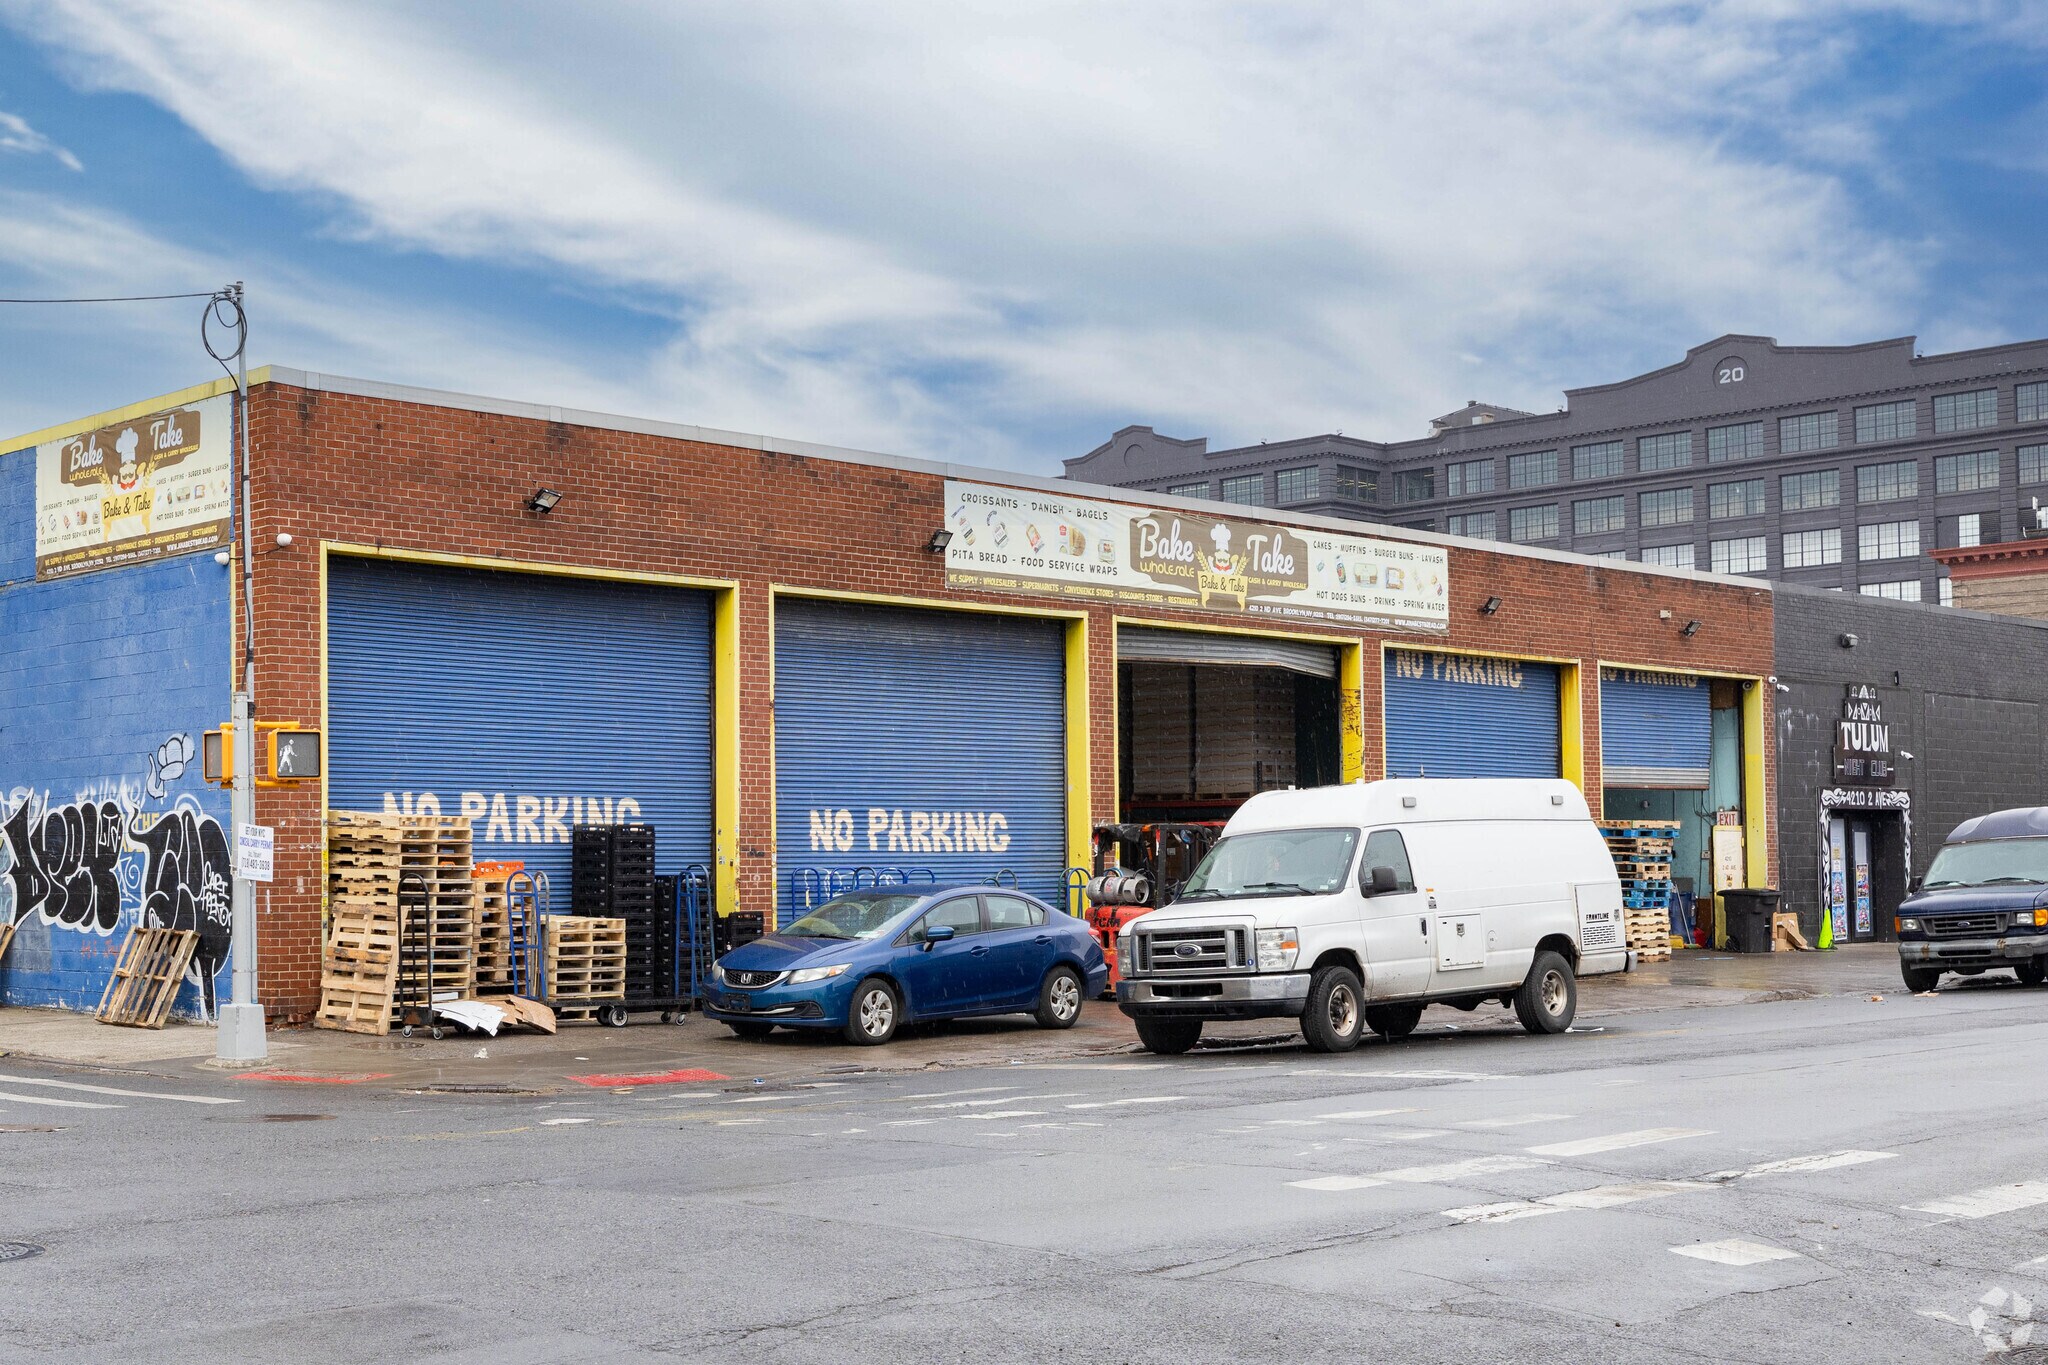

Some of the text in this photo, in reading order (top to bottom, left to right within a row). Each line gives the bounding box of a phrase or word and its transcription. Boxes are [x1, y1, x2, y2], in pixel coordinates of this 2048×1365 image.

[1719, 366, 1744, 384] 20
[149, 414, 184, 451] Take
[70, 434, 104, 473] Bake
[103, 491, 151, 520] Bake & Take
[1076, 508, 1108, 521] BAGELS
[1136, 518, 1195, 563] Bake
[1313, 540, 1332, 550] CAKES
[1374, 548, 1396, 559] BURGER
[1398, 551, 1414, 560] BUNS
[1421, 554, 1444, 564] LAVASH
[979, 552, 1008, 564] BREAD
[1021, 556, 1044, 568] FOOD
[1089, 564, 1118, 576] WRAPS
[1246, 532, 1295, 576] Take
[1140, 560, 1195, 578] wholesale
[949, 574, 958, 582] WE
[958, 574, 978, 584] SUPPLY
[982, 576, 1017, 588] WHOLESALERS
[1022, 578, 1060, 592] SUPERMARKETS
[1064, 585, 1095, 596] CONVENIENCE
[1096, 588, 1114, 598] STORES
[1146, 594, 1164, 603] STORES
[1200, 575, 1246, 593] Bake & Take
[1248, 576, 1260, 584] CASH
[1266, 578, 1282, 587] CARRY
[1282, 580, 1308, 590] WHOLESALE
[1316, 590, 1328, 600] HOT
[1332, 592, 1348, 602] DOGS
[1350, 593, 1366, 604] BUNS
[1426, 602, 1446, 612] WATER
[1396, 650, 1523, 688] NO PARKING
[1840, 722, 1890, 753] TULUM
[1844, 758, 1888, 777] NIGHT CLUB
[1846, 790, 1887, 807] 4210 2 AVE
[460, 792, 645, 844] PARKING
[809, 808, 1011, 852] NO PARKING
[1719, 813, 1736, 826] EXIT
